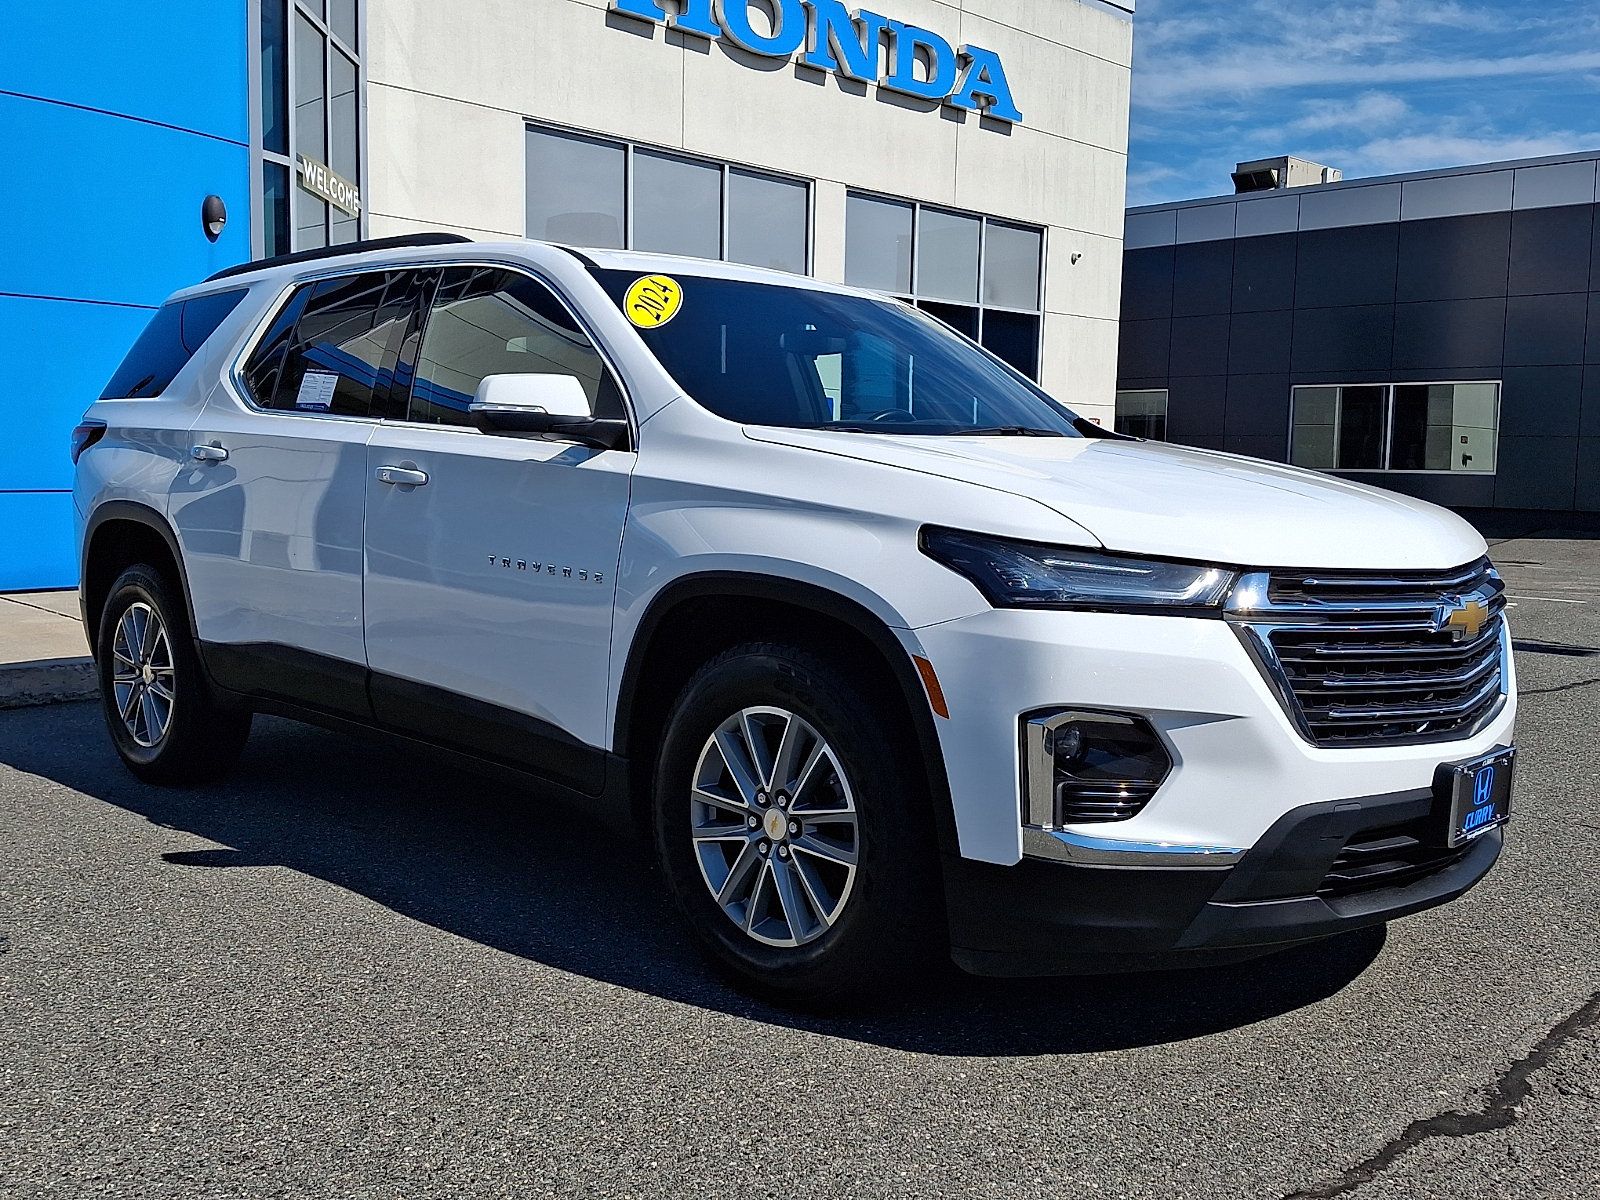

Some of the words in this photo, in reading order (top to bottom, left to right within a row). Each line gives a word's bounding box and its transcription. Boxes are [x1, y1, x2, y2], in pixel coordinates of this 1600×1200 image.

[303, 158, 358, 212] WELCOME
[634, 278, 673, 321] 2024
[488, 555, 603, 583] TRAVERSE
[1465, 803, 1495, 829] CURRY
